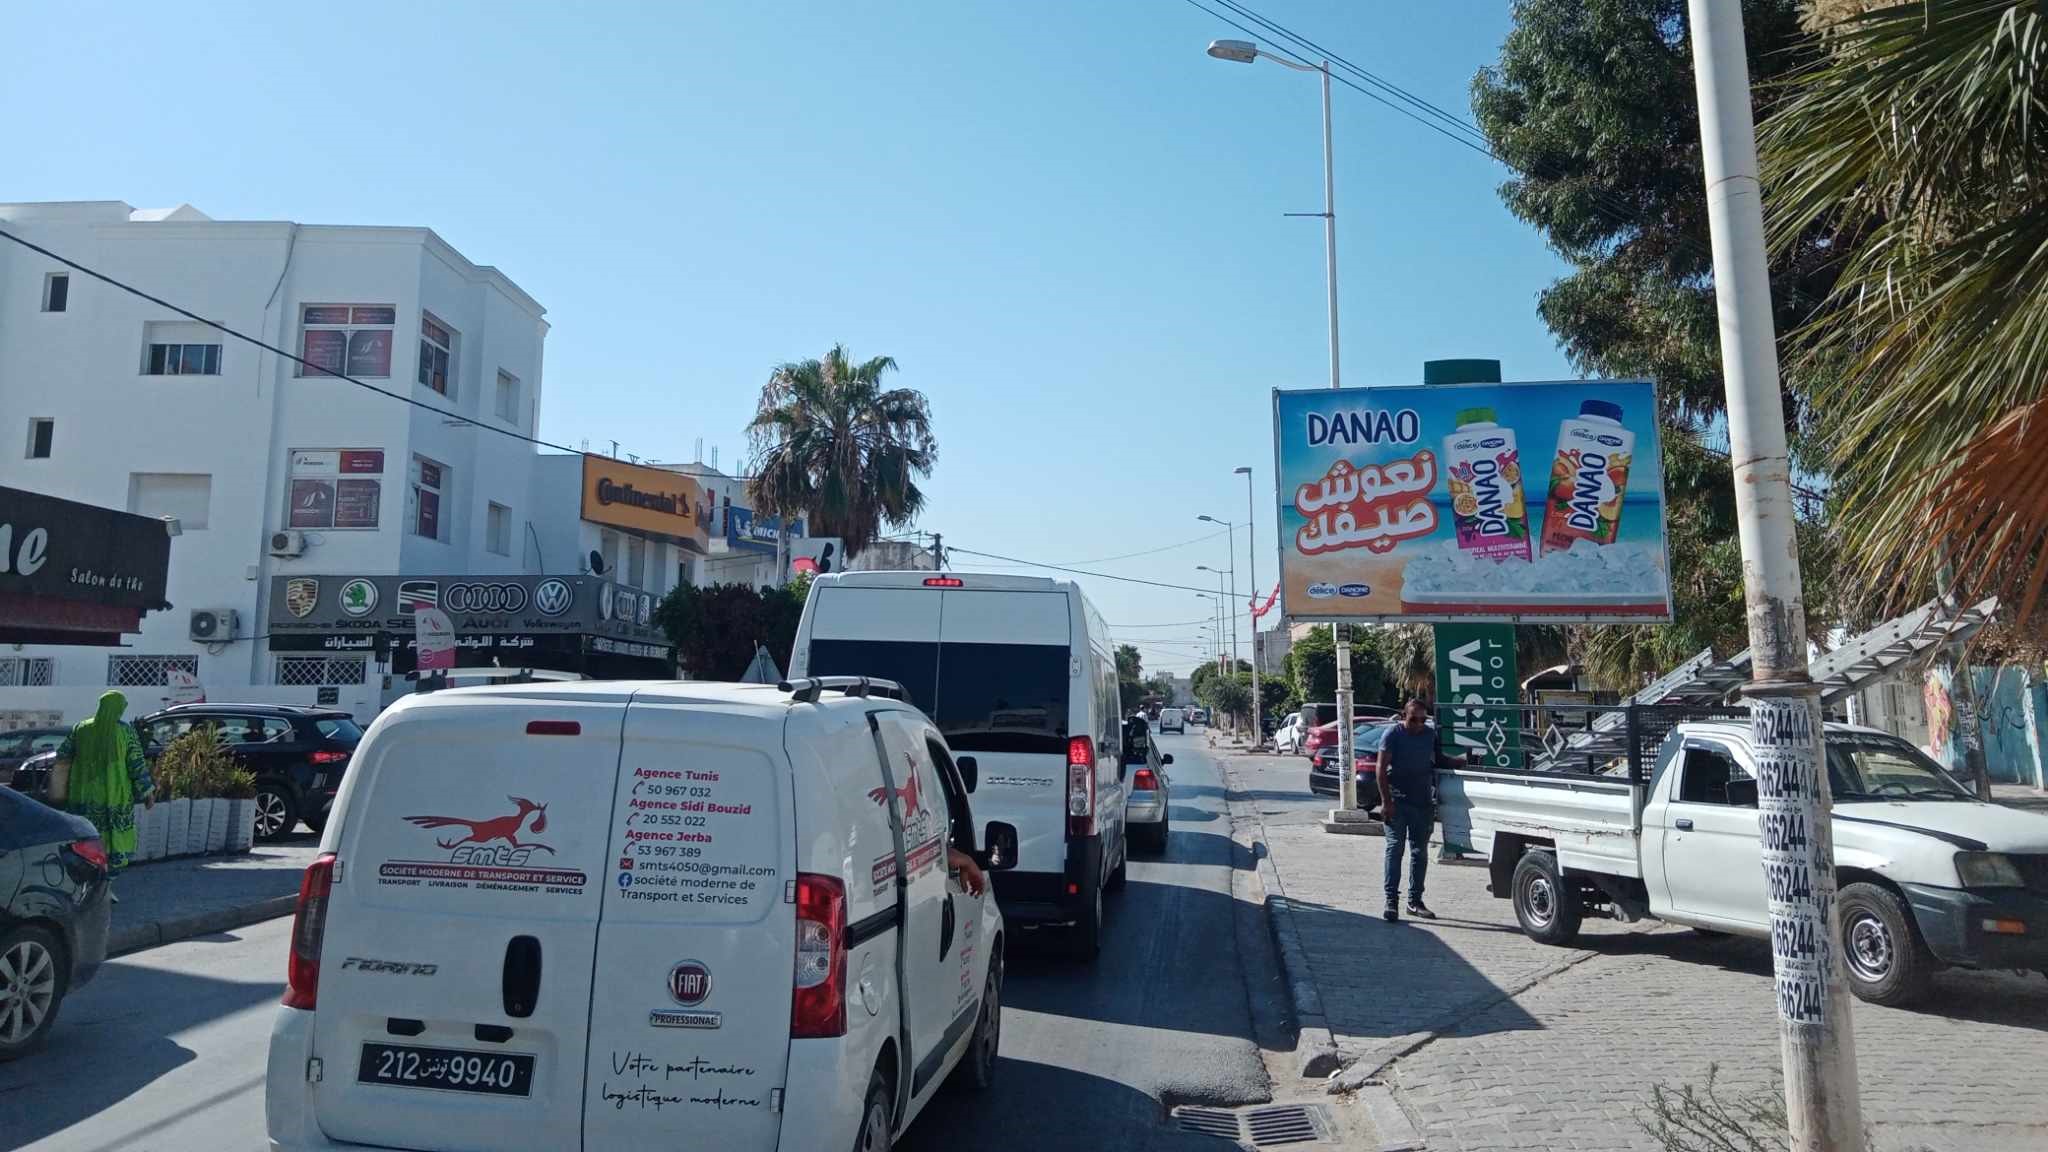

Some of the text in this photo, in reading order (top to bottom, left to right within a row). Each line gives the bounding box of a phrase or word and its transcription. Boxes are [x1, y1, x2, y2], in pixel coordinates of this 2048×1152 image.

[1308, 409, 1419, 445] DANAO
[1471, 459, 1508, 535] DANAO
[1568, 452, 1607, 530] DANAO
[1299, 500, 1434, 550] صيفك
[70, 567, 105, 588] Salon
[109, 573, 122, 588] de
[324, 635, 374, 649] السيارات
[499, 635, 534, 649] شركة
[634, 767, 720, 782] Agence Tunis
[647, 785, 712, 798] 50 967 032
[629, 798, 751, 815] Agence Sidi Bouzid
[643, 814, 706, 827] 20 552 022
[625, 829, 712, 843] Agence Jerba
[450, 845, 531, 866] smts
[637, 845, 702, 858] 53 967 389
[418, 867, 462, 878] MODERNE
[464, 869, 476, 878] DE
[478, 871, 530, 882] TRANSPORT
[532, 873, 544, 882] ET
[545, 874, 584, 885] SERVICE
[639, 861, 776, 877] smts4050@gmail.com
[378, 878, 421, 886] TRANSPORT
[428, 880, 469, 889] LIVRAISON
[545, 886, 583, 895] SERVICES
[634, 875, 756, 890] société moderne de
[620, 889, 748, 905] Transport et Services
[678, 974, 703, 994] FIAT
[654, 1014, 717, 1025] PROFESSIONAL
[378, 1051, 516, 1088] 212 تونس 9940
[612, 1051, 755, 1080] Votre partenaire
[602, 1082, 760, 1112] logistique moderne
